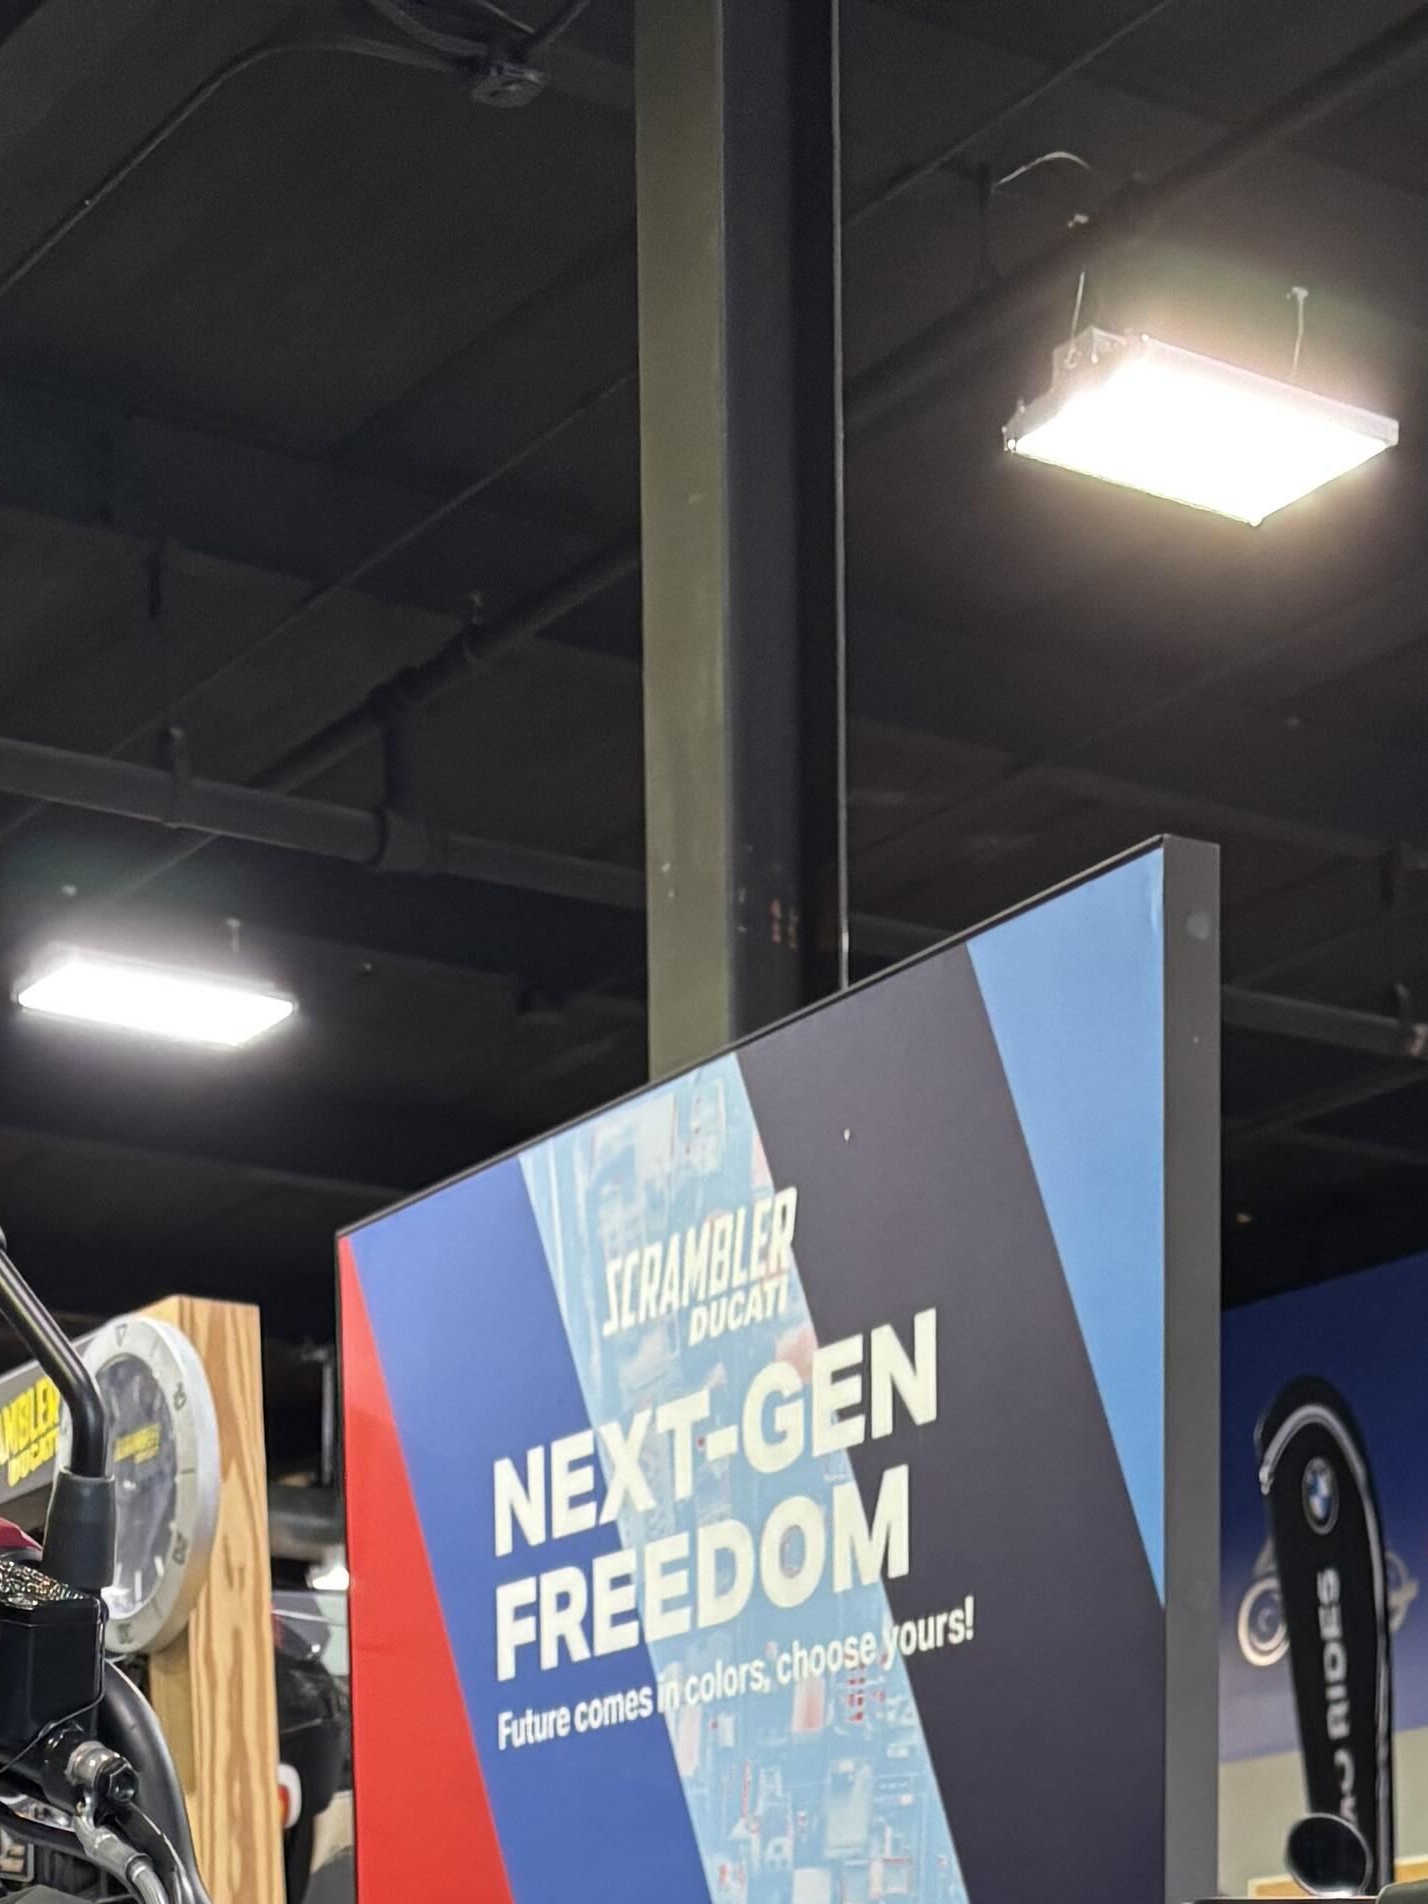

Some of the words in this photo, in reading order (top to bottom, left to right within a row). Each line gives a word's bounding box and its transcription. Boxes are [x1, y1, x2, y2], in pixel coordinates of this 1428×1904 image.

[602, 1186, 797, 1337] SCRAMBLER
[689, 1274, 789, 1347] DUCATI
[494, 1307, 938, 1557] NEXT-GEN
[496, 1464, 909, 1682] FREEDOM
[1316, 1567, 1350, 1741] RIDES
[498, 1708, 570, 1751] Future
[574, 1688, 653, 1731] comes
[658, 1676, 680, 1714] in
[684, 1651, 771, 1705] colors,
[777, 1628, 877, 1686] choose
[881, 1596, 975, 1673] yours!
